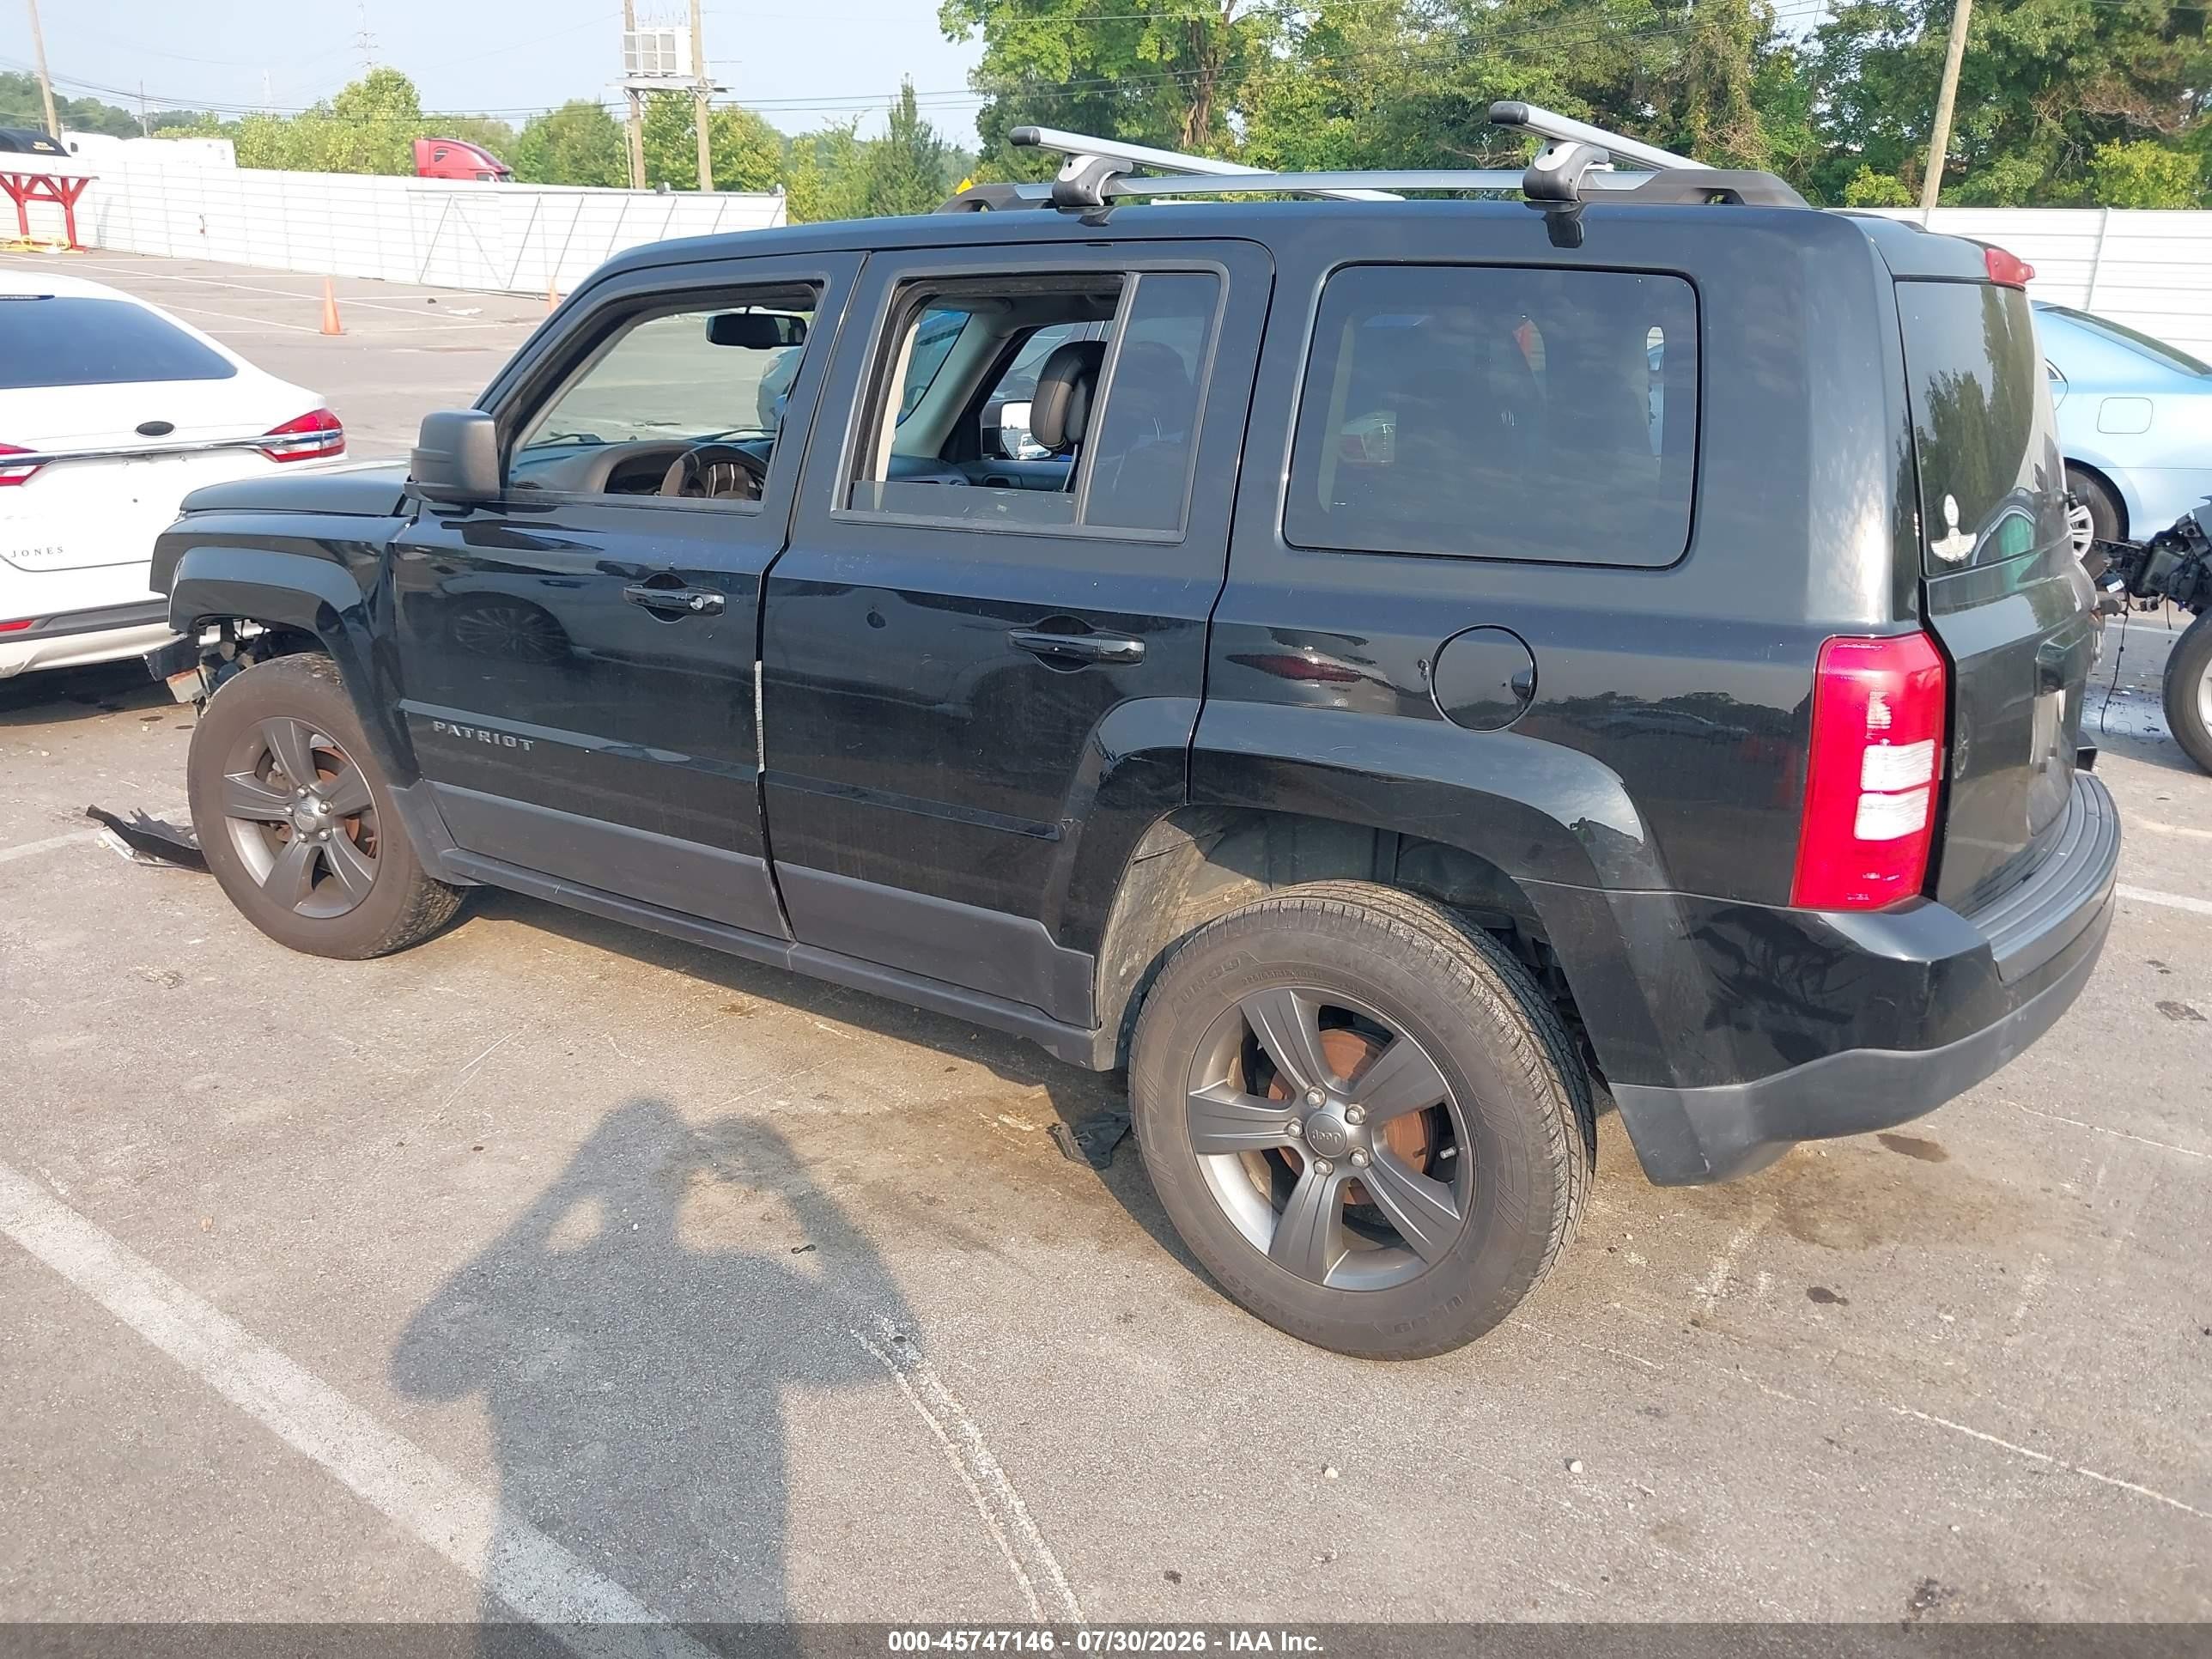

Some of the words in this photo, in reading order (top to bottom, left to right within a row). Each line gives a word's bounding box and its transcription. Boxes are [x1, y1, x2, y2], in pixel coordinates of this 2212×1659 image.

[10, 546, 64, 558] JONES
[432, 720, 534, 751] PATRIOT
[1311, 1129, 1343, 1145] Jeep
